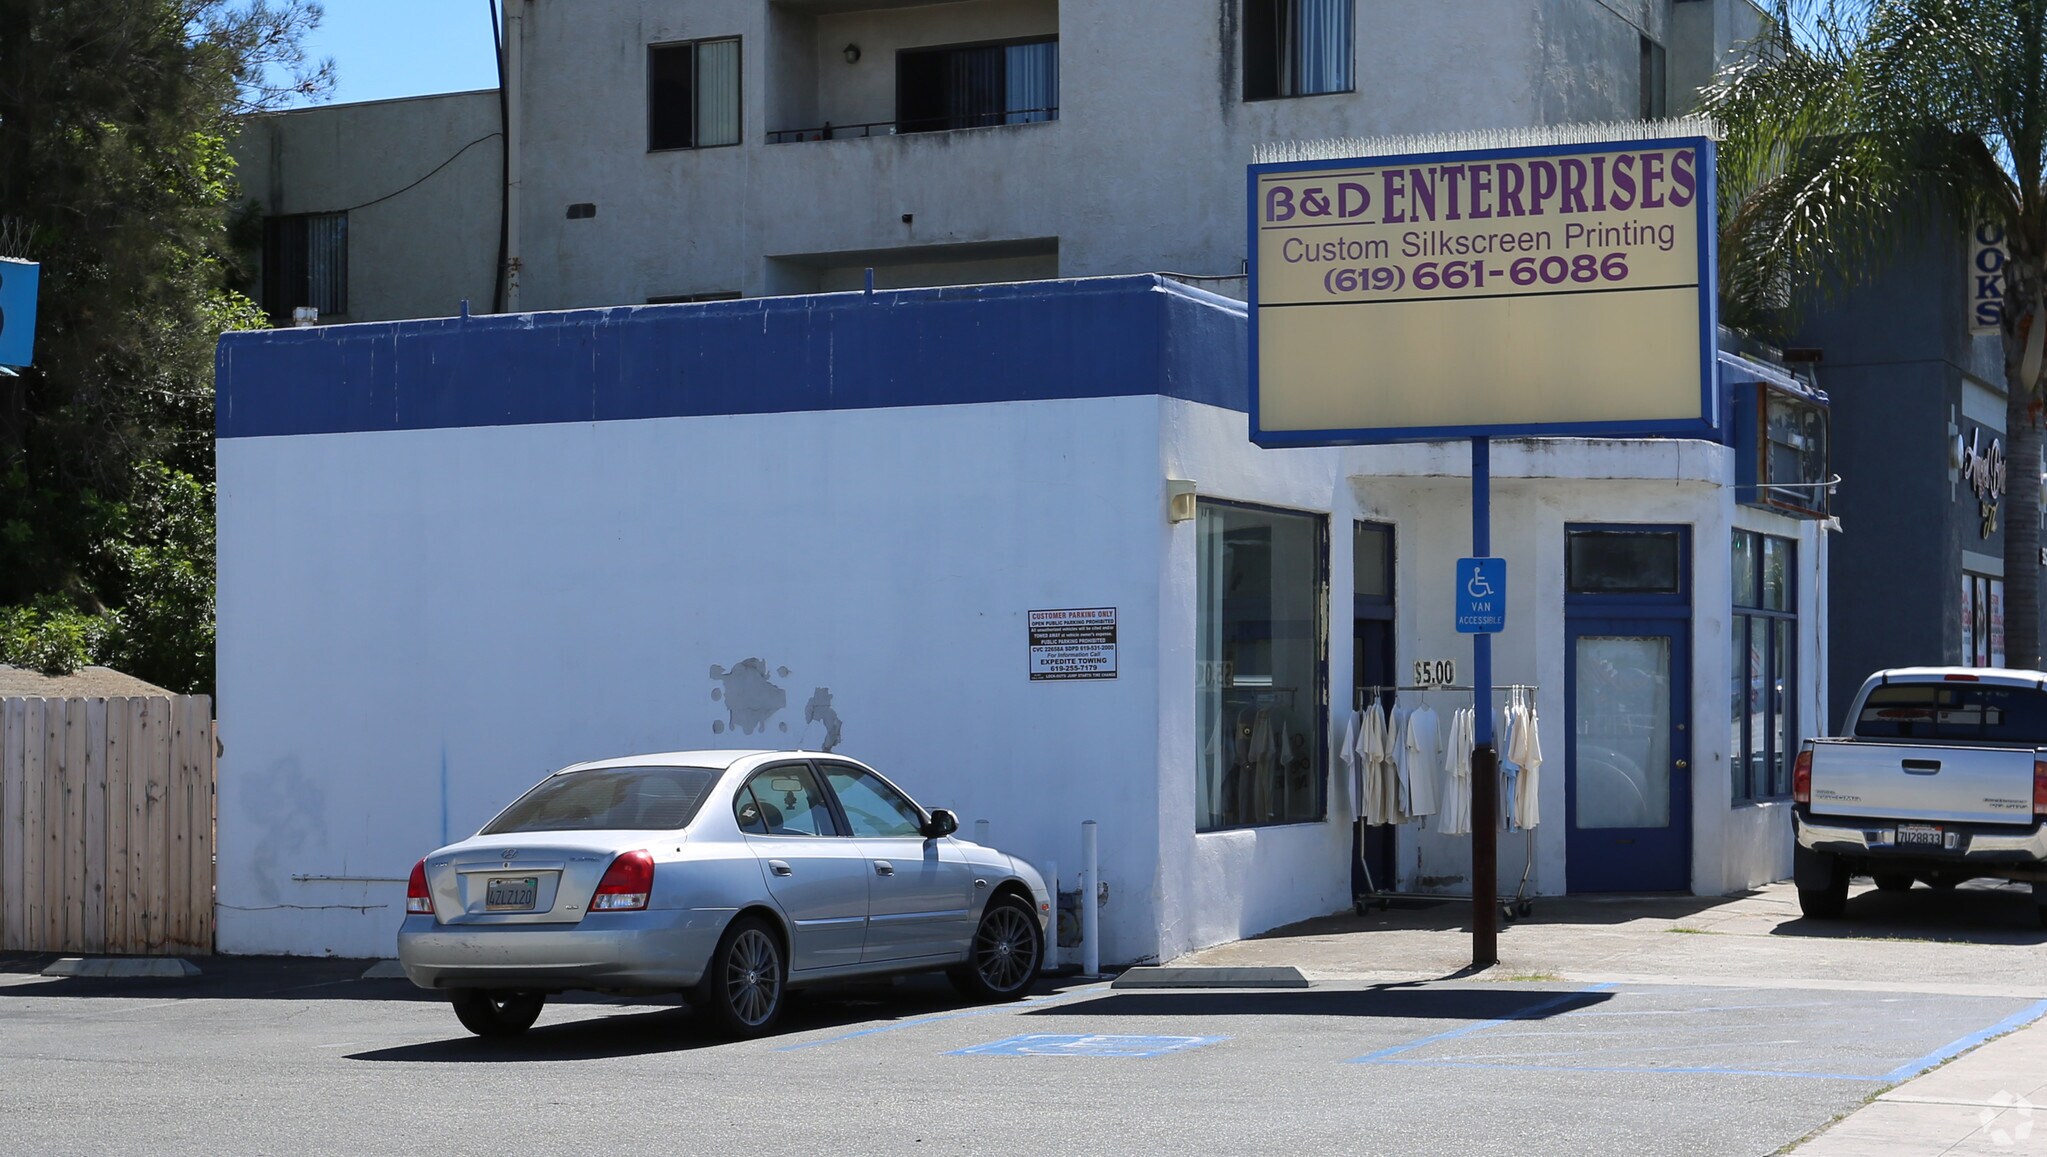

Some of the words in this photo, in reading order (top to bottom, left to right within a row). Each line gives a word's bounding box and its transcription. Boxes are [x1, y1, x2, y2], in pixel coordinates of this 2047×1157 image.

[1266, 182, 1370, 222] B&D
[1381, 150, 1696, 224] ENTERPRISES
[1282, 236, 1389, 264] Custom
[1401, 228, 1551, 258] Silkscreen
[1565, 219, 1675, 251] Printing
[1324, 264, 1406, 295] (619)
[1412, 252, 1629, 290] 661-6086
[1471, 602, 1491, 612] VAN
[1032, 612, 1067, 620] CUSTOMER
[1459, 616, 1502, 625] ACCESSIBLE
[1415, 660, 1454, 686] $5.00
[1899, 832, 1941, 845] 7U28833
[489, 889, 532, 905] 4ZLZ120
